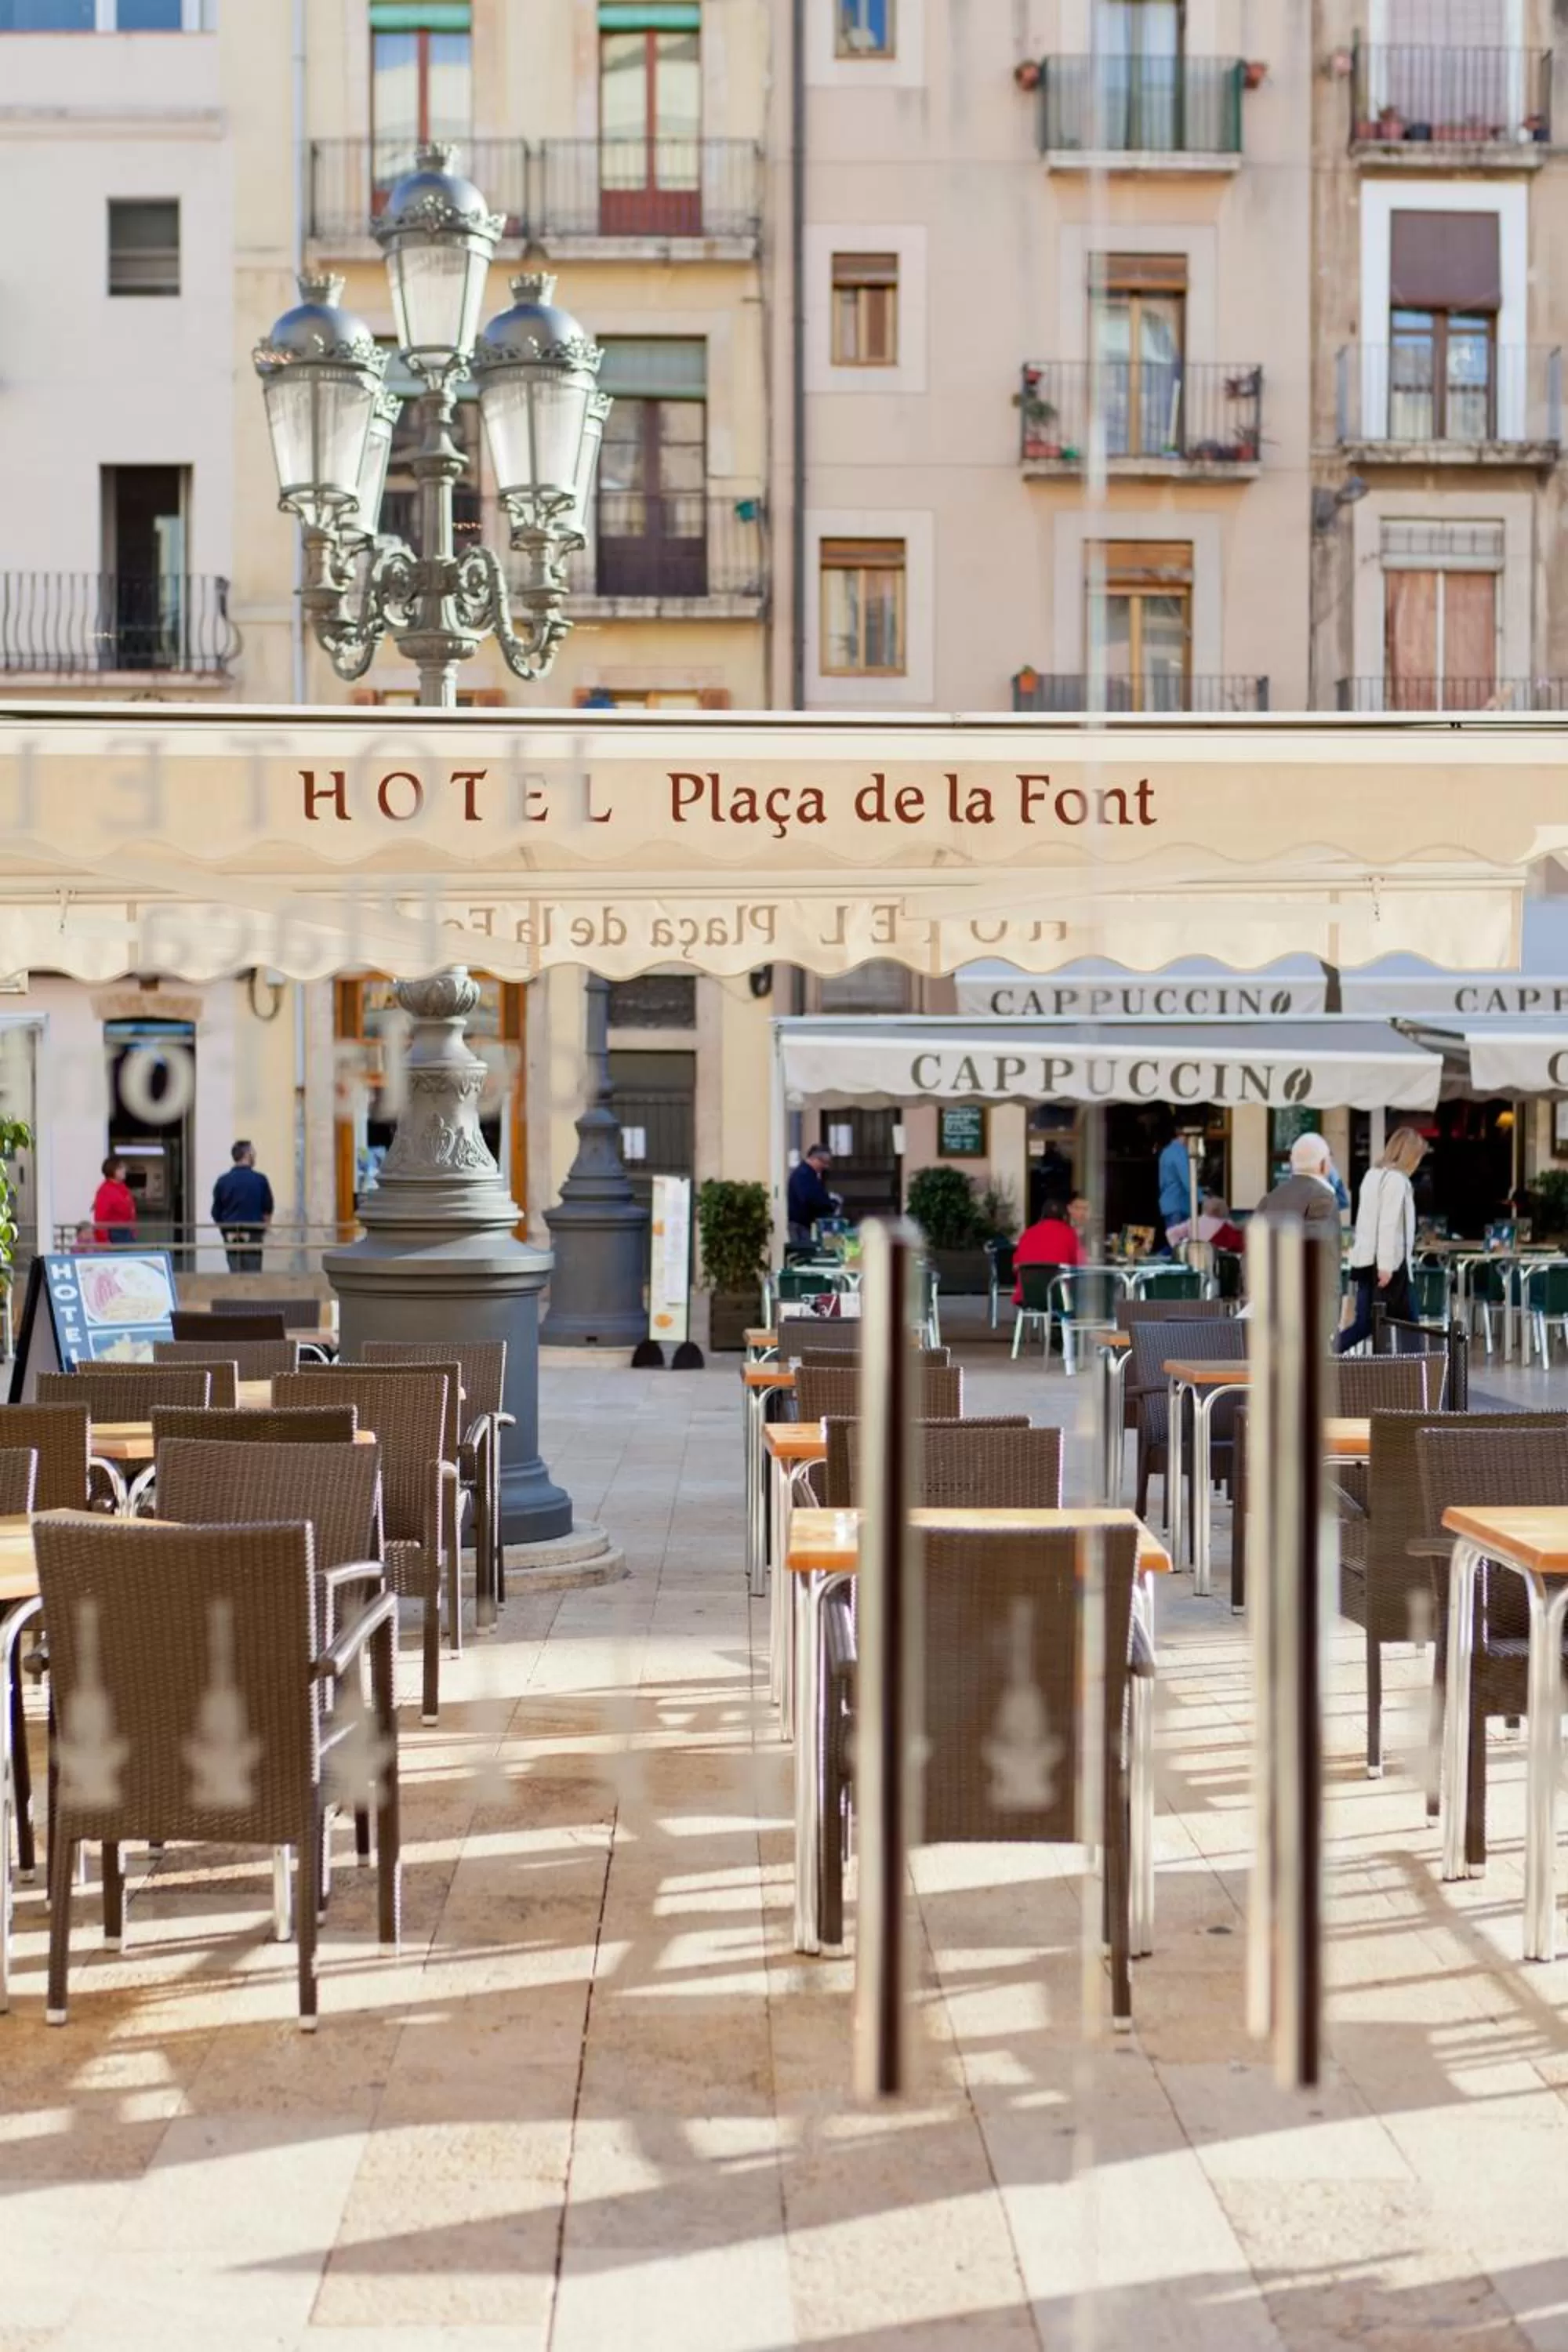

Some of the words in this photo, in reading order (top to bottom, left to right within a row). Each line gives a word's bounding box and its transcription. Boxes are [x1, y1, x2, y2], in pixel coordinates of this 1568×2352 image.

[299, 771, 612, 823] HOTEL
[668, 773, 826, 838] Plaça
[855, 773, 925, 824] de
[944, 774, 995, 825] la
[1016, 775, 1156, 826] Font
[50, 1263, 82, 1364] HOTEL
